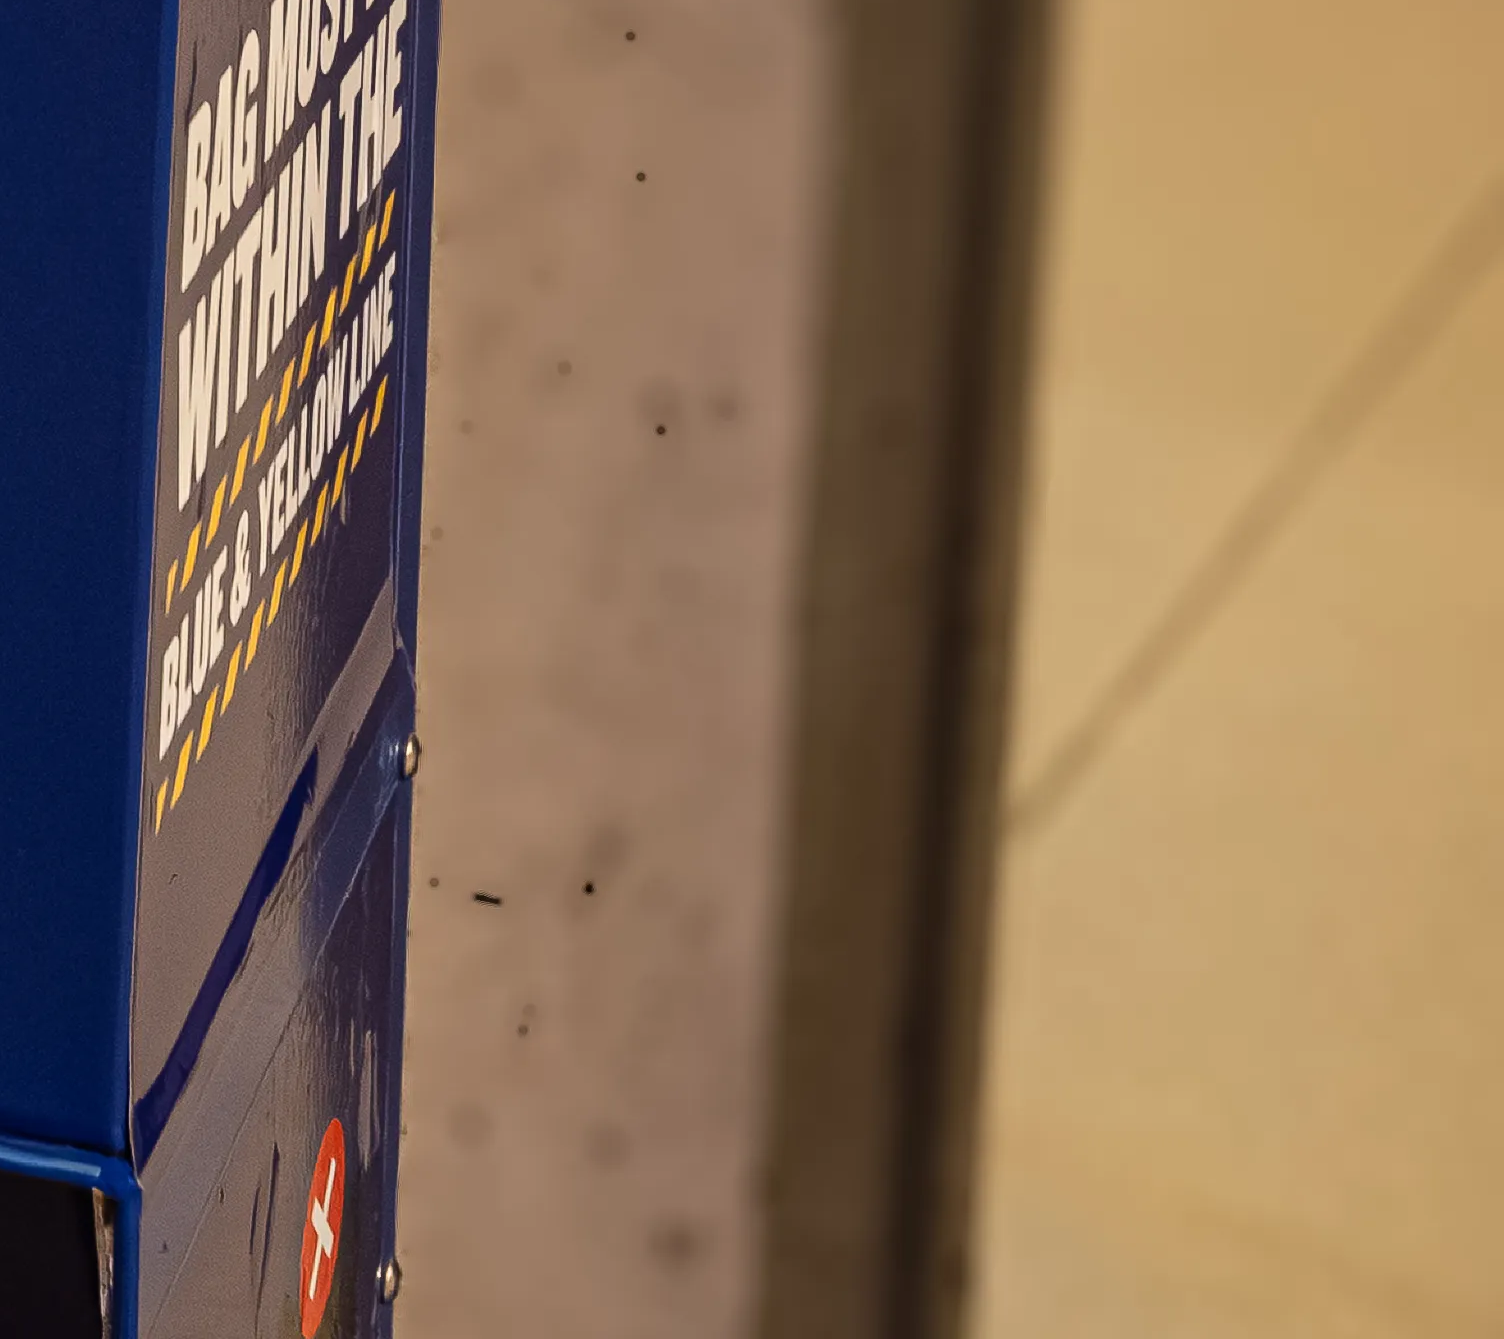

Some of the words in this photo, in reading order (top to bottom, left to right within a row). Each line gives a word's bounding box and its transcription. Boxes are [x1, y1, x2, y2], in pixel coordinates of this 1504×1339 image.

[178, 99, 332, 513] WITHIN
[180, 27, 261, 294] BAG
[158, 544, 228, 763] BLUE
[229, 509, 252, 628] &
[257, 333, 349, 579] YELLOW
[347, 250, 397, 415] LINE
